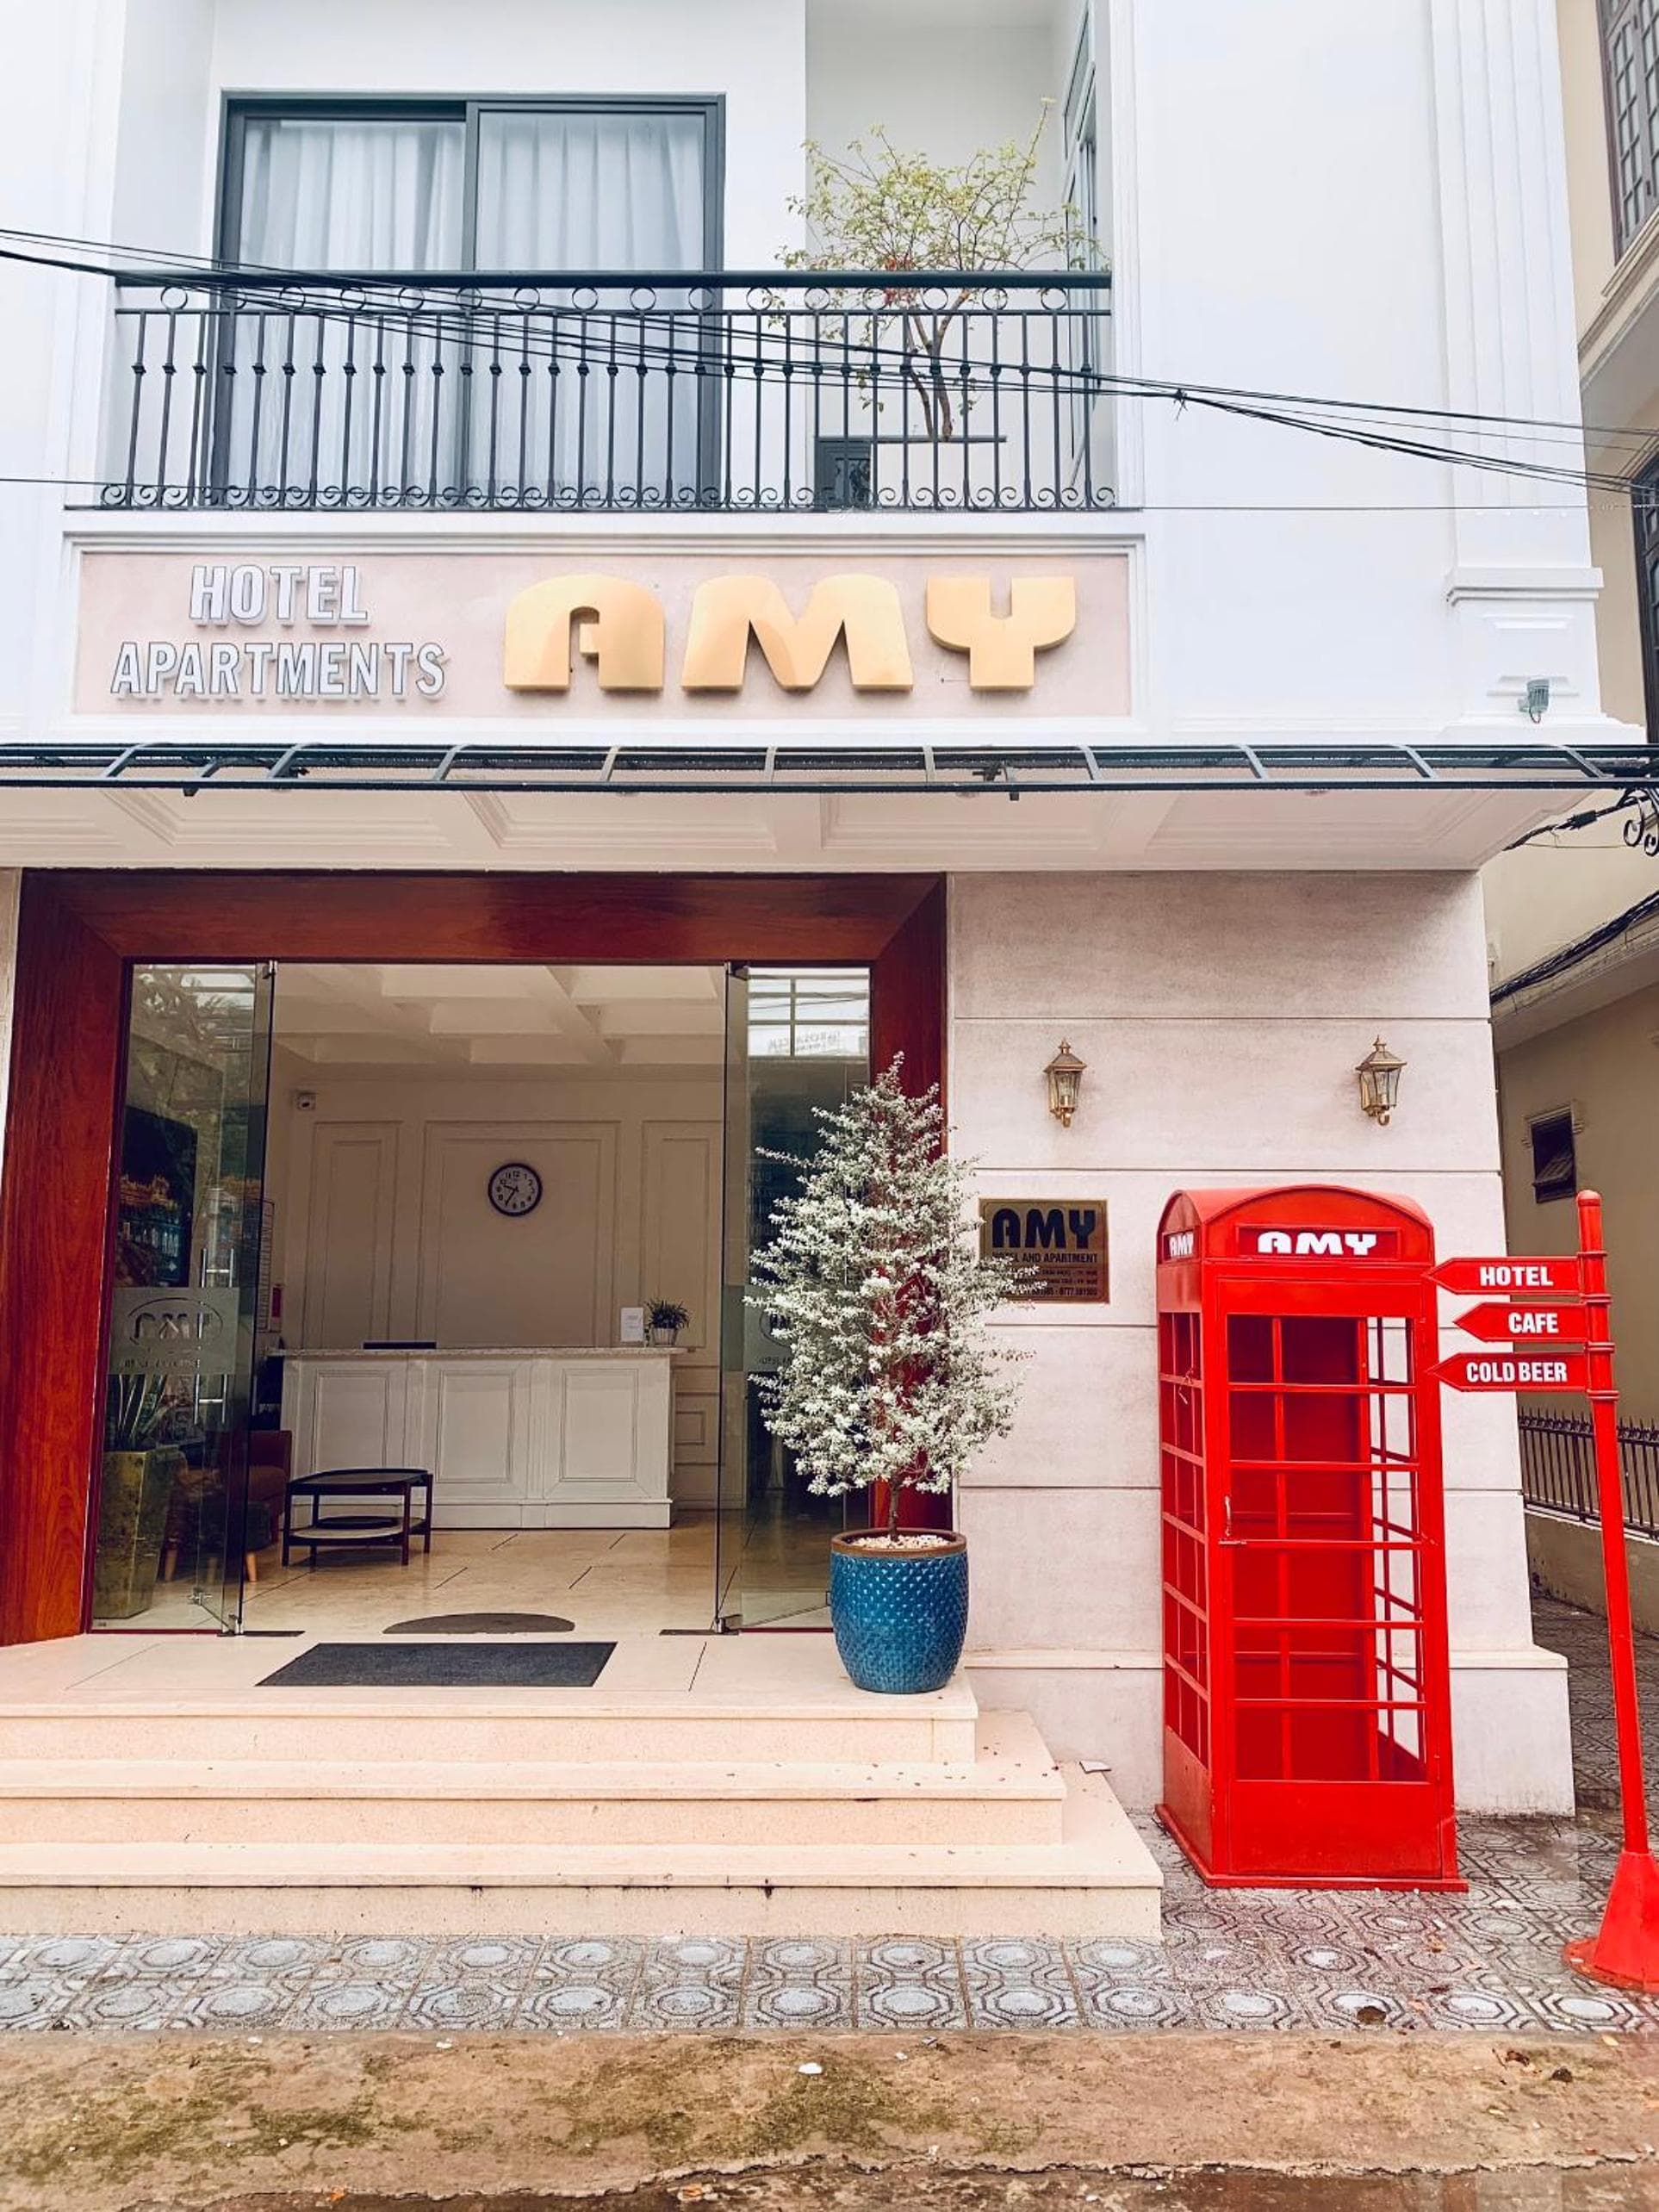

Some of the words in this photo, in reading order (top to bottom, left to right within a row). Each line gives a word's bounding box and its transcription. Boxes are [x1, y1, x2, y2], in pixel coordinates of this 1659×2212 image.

[189, 565, 370, 627] HOTEL
[504, 574, 1077, 692] AMY
[110, 641, 447, 699] APARTMENTS
[991, 1208, 1097, 1249] AMY
[1169, 1233, 1195, 1258] AMY
[1258, 1231, 1377, 1256] AMY
[1022, 1252, 1042, 1263] AND
[1043, 1252, 1098, 1264] APARTMENT
[1479, 1265, 1554, 1287] HOTEL
[1507, 1312, 1559, 1334] CAFE
[1466, 1361, 1516, 1382] COLD
[1518, 1361, 1569, 1382] BEER
